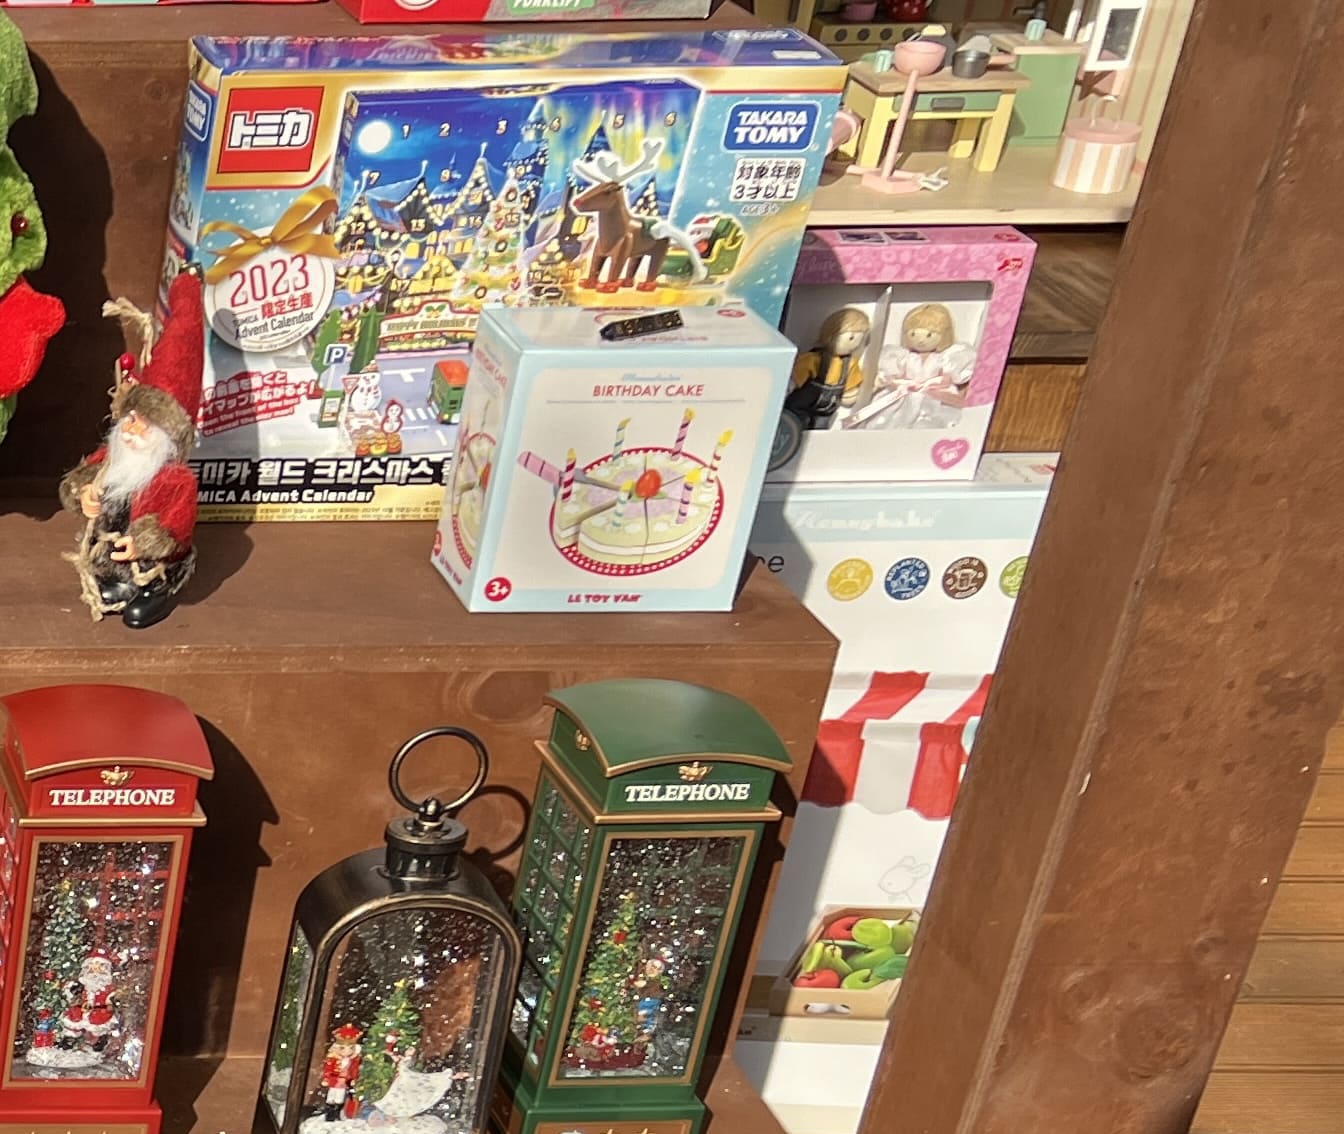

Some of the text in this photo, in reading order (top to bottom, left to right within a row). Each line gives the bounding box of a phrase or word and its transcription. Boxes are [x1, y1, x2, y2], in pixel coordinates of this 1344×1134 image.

[737, 110, 808, 126] TAKARA
[228, 110, 312, 148] トミカ
[733, 126, 807, 145] TOMY
[733, 183, 797, 201] 3才以上
[229, 253, 311, 308] 2023
[270, 311, 315, 332] Calendar
[331, 349, 344, 361] P
[592, 383, 705, 398] BIRTHDAY CAKE
[257, 460, 305, 486] 월드
[312, 458, 434, 485] 크리스마스
[199, 488, 374, 503] MICA Advent Calendar
[488, 581, 509, 598] 3+
[585, 594, 610, 603] TOY
[49, 789, 176, 806] TELEPHONE
[624, 783, 751, 803] TELEPHONE
